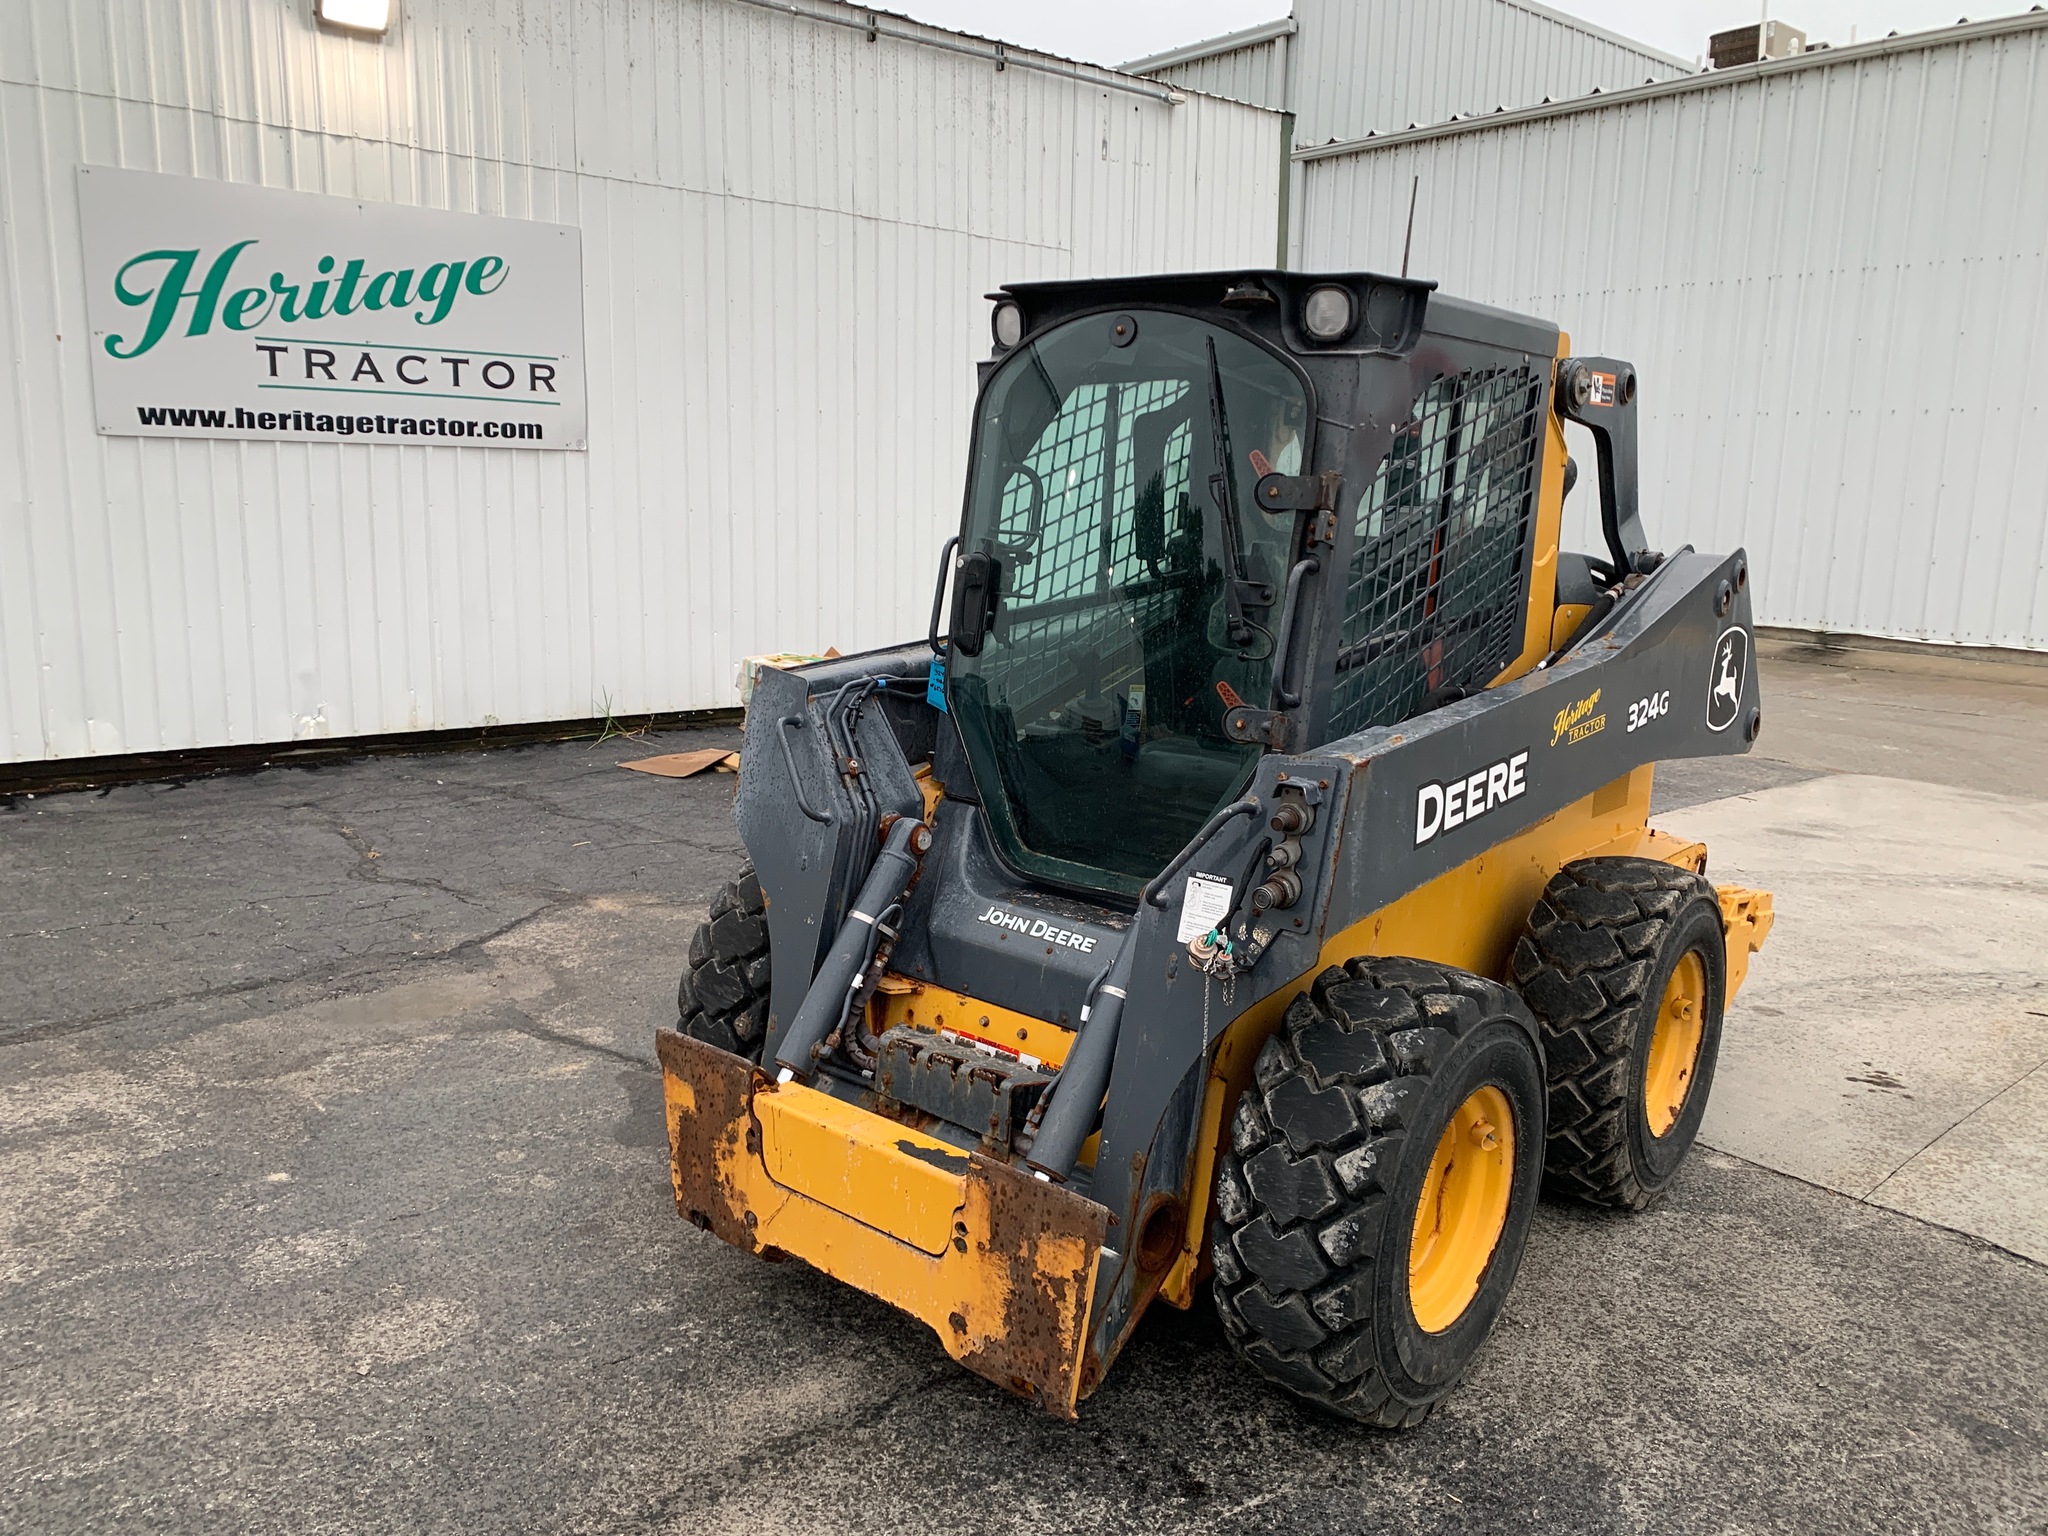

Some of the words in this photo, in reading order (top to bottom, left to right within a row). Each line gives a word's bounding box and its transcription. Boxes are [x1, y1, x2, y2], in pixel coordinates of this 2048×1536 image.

[104, 239, 510, 359] Heritage
[255, 343, 558, 393] TRACTOR
[136, 406, 543, 440] www.heritagetractor.com
[1550, 687, 1602, 747] Heritage
[1568, 716, 1606, 742] TRACTOR
[1627, 690, 1670, 733] 324G
[1415, 751, 1528, 845] DEERE
[1195, 871, 1227, 884] IMPORTANT
[978, 906, 1031, 934] JOHN
[1031, 919, 1098, 954] DEERE
